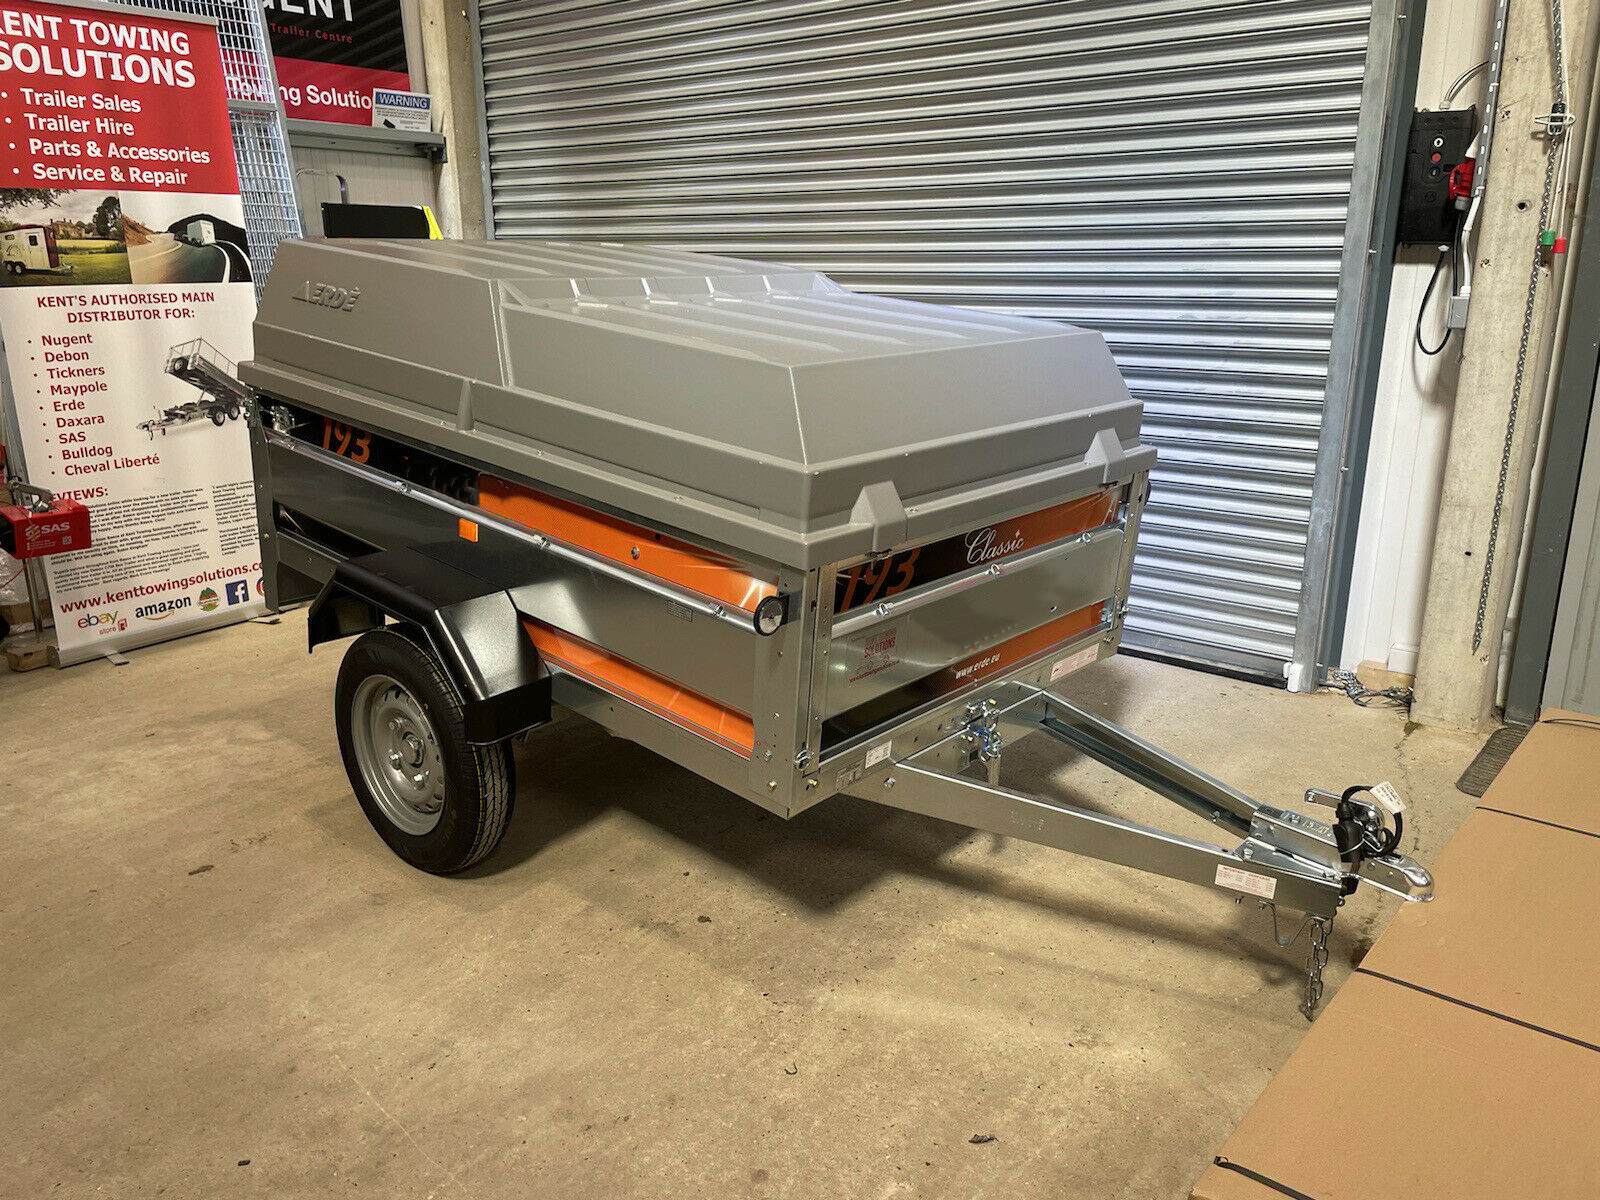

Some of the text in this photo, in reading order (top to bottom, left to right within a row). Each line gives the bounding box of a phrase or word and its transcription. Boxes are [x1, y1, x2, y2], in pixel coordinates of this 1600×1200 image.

[0, 10, 190, 55] ENT TOWING
[271, 22, 354, 43] Trailer Centre
[0, 41, 196, 88] SOLUTIONS
[20, 87, 142, 113] Trailer Sales
[306, 84, 373, 110] Solutio
[379, 93, 428, 108] WARNING
[24, 113, 135, 136] Trailer Hire
[29, 138, 211, 164] Parts & Accessories
[33, 163, 189, 187] Service & Repair
[37, 291, 215, 308] KENT'S AUTHORISED MAIN
[67, 308, 196, 324] DISTRIBUTOR FOR:
[41, 333, 94, 347] Nugent
[44, 350, 90, 363] Debon
[47, 365, 106, 380] Tickners
[50, 381, 108, 398] Maypole
[53, 399, 86, 412] Erde
[56, 414, 105, 428] Daxara
[59, 432, 87, 445] SAS
[62, 445, 113, 461] Bulldog
[64, 453, 161, 477] Cheval Liberté
[41, 521, 71, 534] SAS
[965, 527, 1026, 565] Classic
[77, 610, 118, 629] ebay
[135, 596, 191, 617] amazon
[99, 625, 117, 635] store
